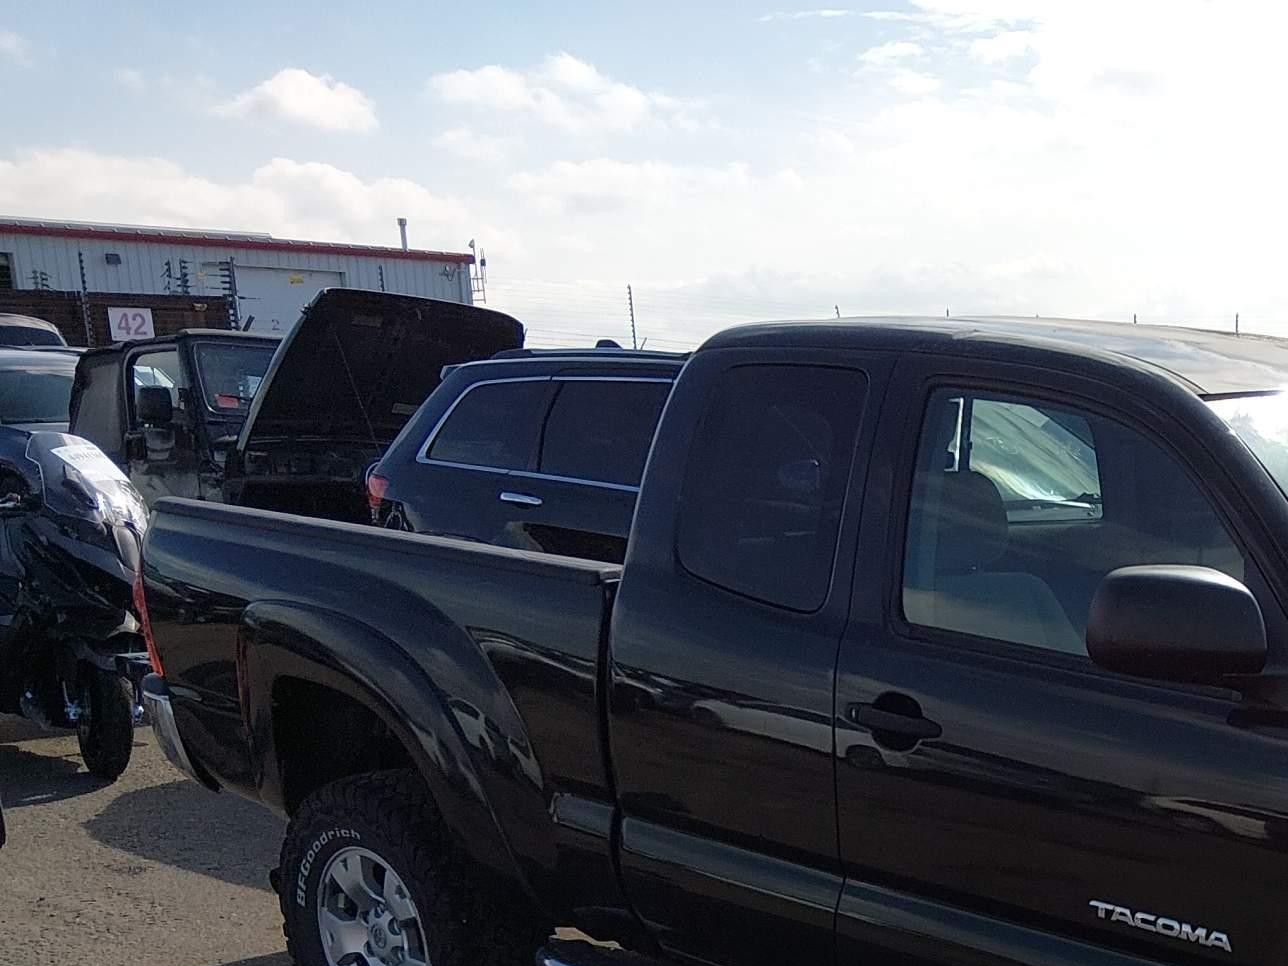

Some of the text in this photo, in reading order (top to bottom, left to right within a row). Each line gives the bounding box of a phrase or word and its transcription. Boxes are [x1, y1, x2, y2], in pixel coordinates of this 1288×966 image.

[117, 312, 147, 336] 42
[296, 828, 361, 907] BFGoodrich
[1089, 900, 1232, 953] TACOMA
